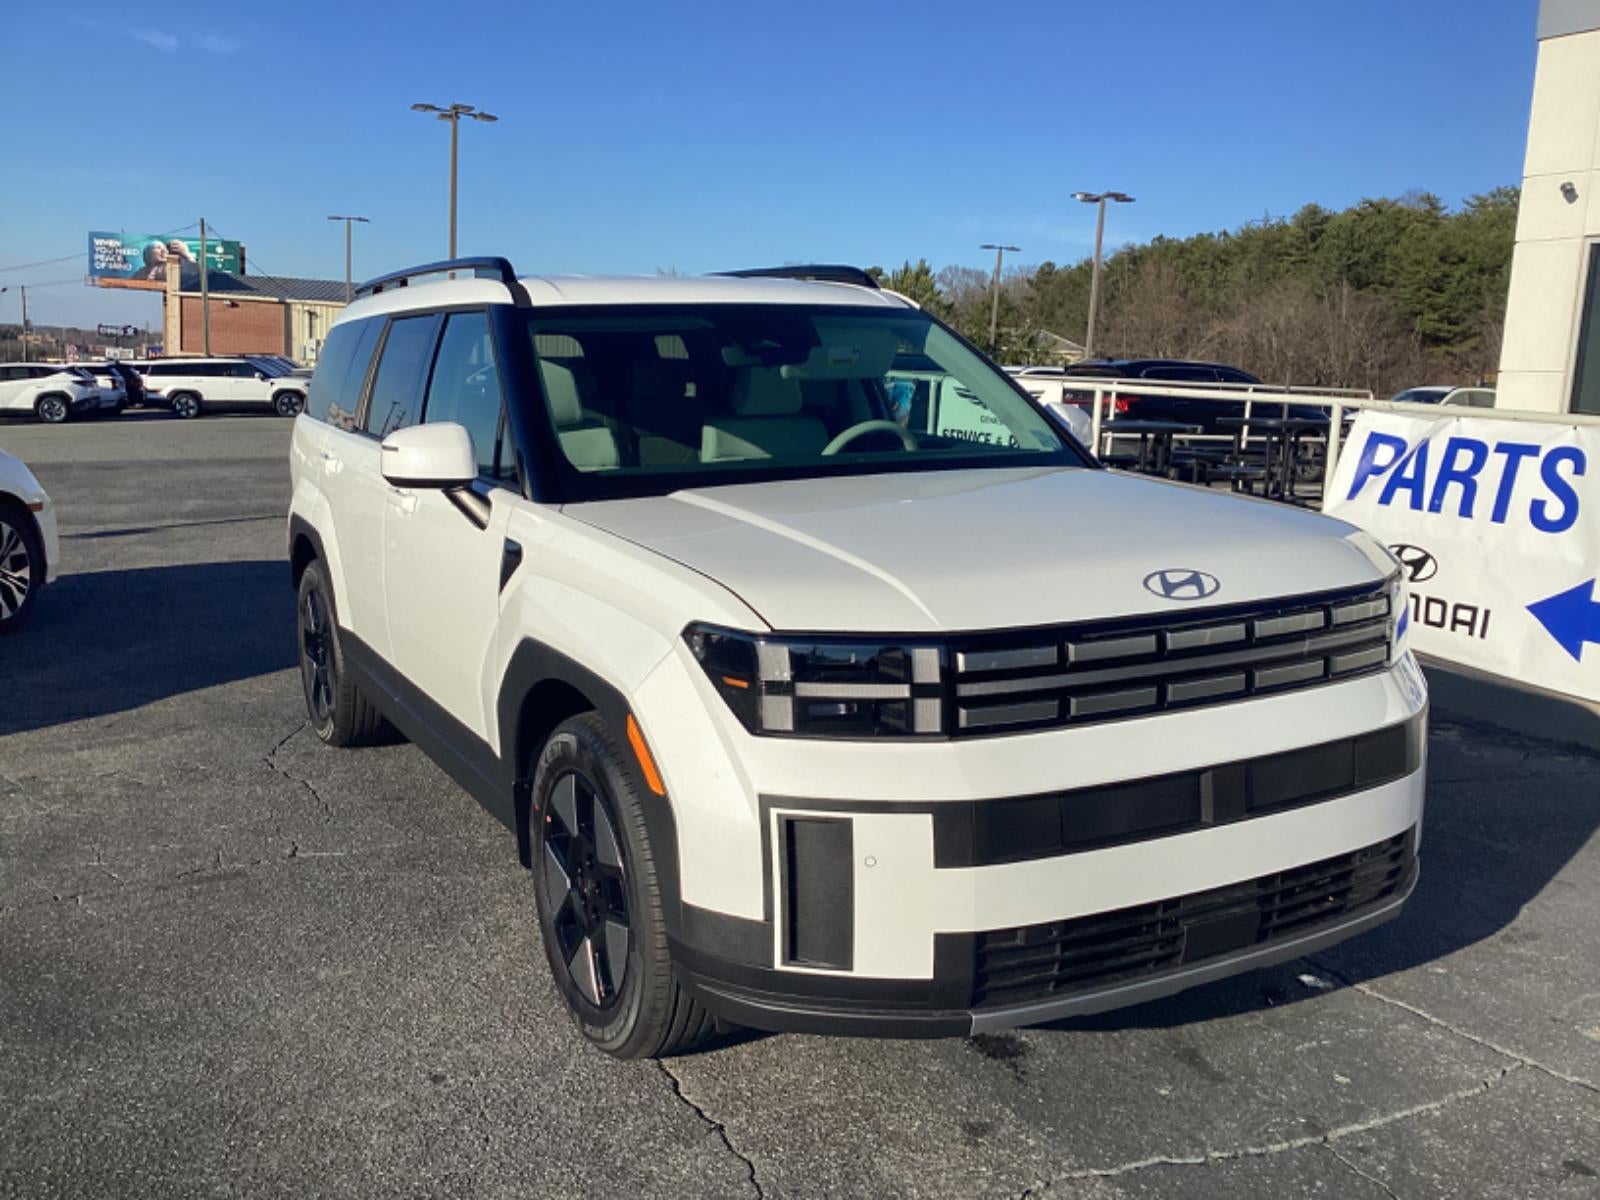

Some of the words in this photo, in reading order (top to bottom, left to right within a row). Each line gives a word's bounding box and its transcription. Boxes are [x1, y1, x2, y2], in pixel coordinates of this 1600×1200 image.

[94, 238, 121, 247] WHEN
[95, 247, 114, 255] YOU
[115, 248, 140, 256] NEED
[95, 254, 122, 263] PEACE
[95, 261, 107, 269] OF
[1346, 431, 1587, 534] PARTS
